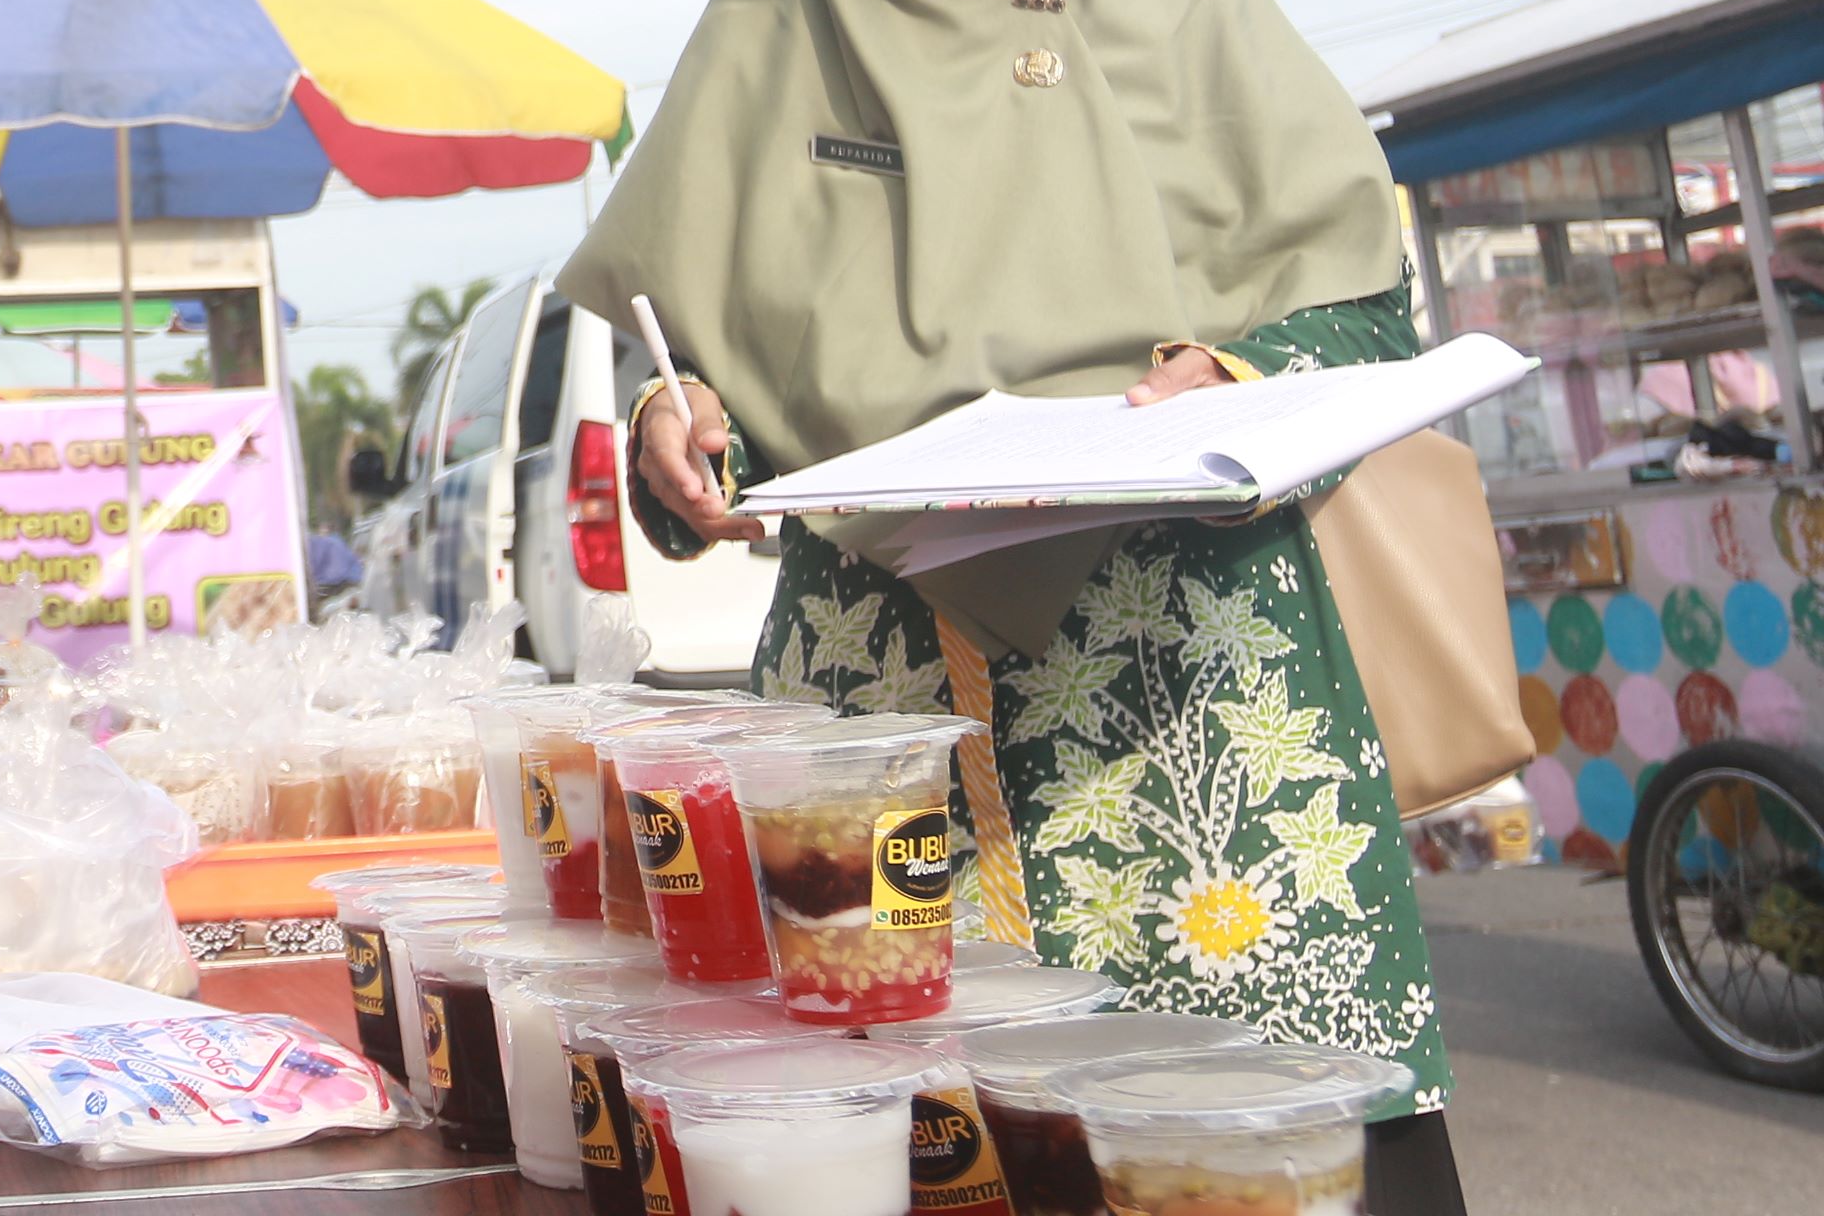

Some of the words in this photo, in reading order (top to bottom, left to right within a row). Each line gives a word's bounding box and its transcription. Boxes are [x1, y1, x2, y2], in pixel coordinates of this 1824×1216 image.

[97, 500, 231, 536] Gung
[631, 810, 677, 837] BUR
[887, 832, 950, 865] BUBU
[911, 1115, 972, 1146] BUR
